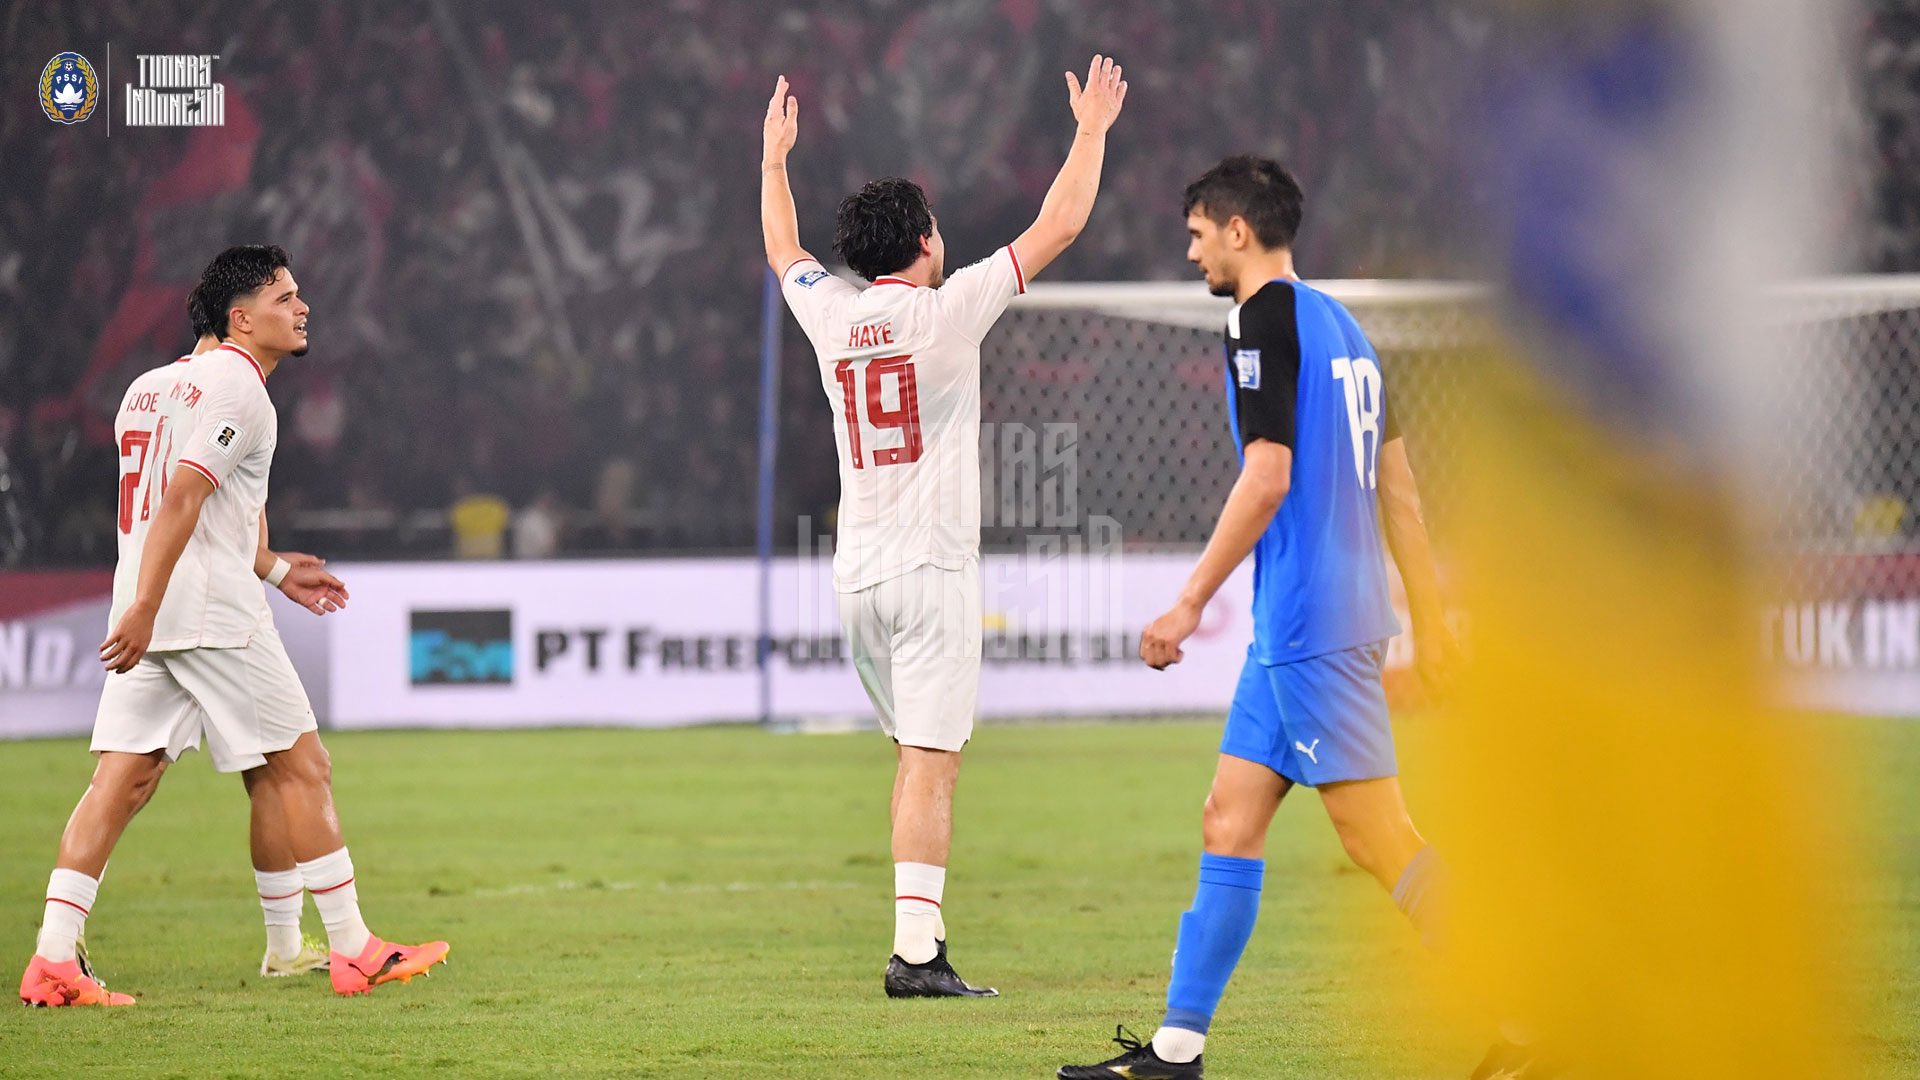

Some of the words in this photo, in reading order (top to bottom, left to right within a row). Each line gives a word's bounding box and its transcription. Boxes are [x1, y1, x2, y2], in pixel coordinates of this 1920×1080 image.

[849, 321, 894, 347] HAYE
[834, 354, 924, 470] 19
[1330, 356, 1382, 490] 18
[534, 628, 608, 673] PT
